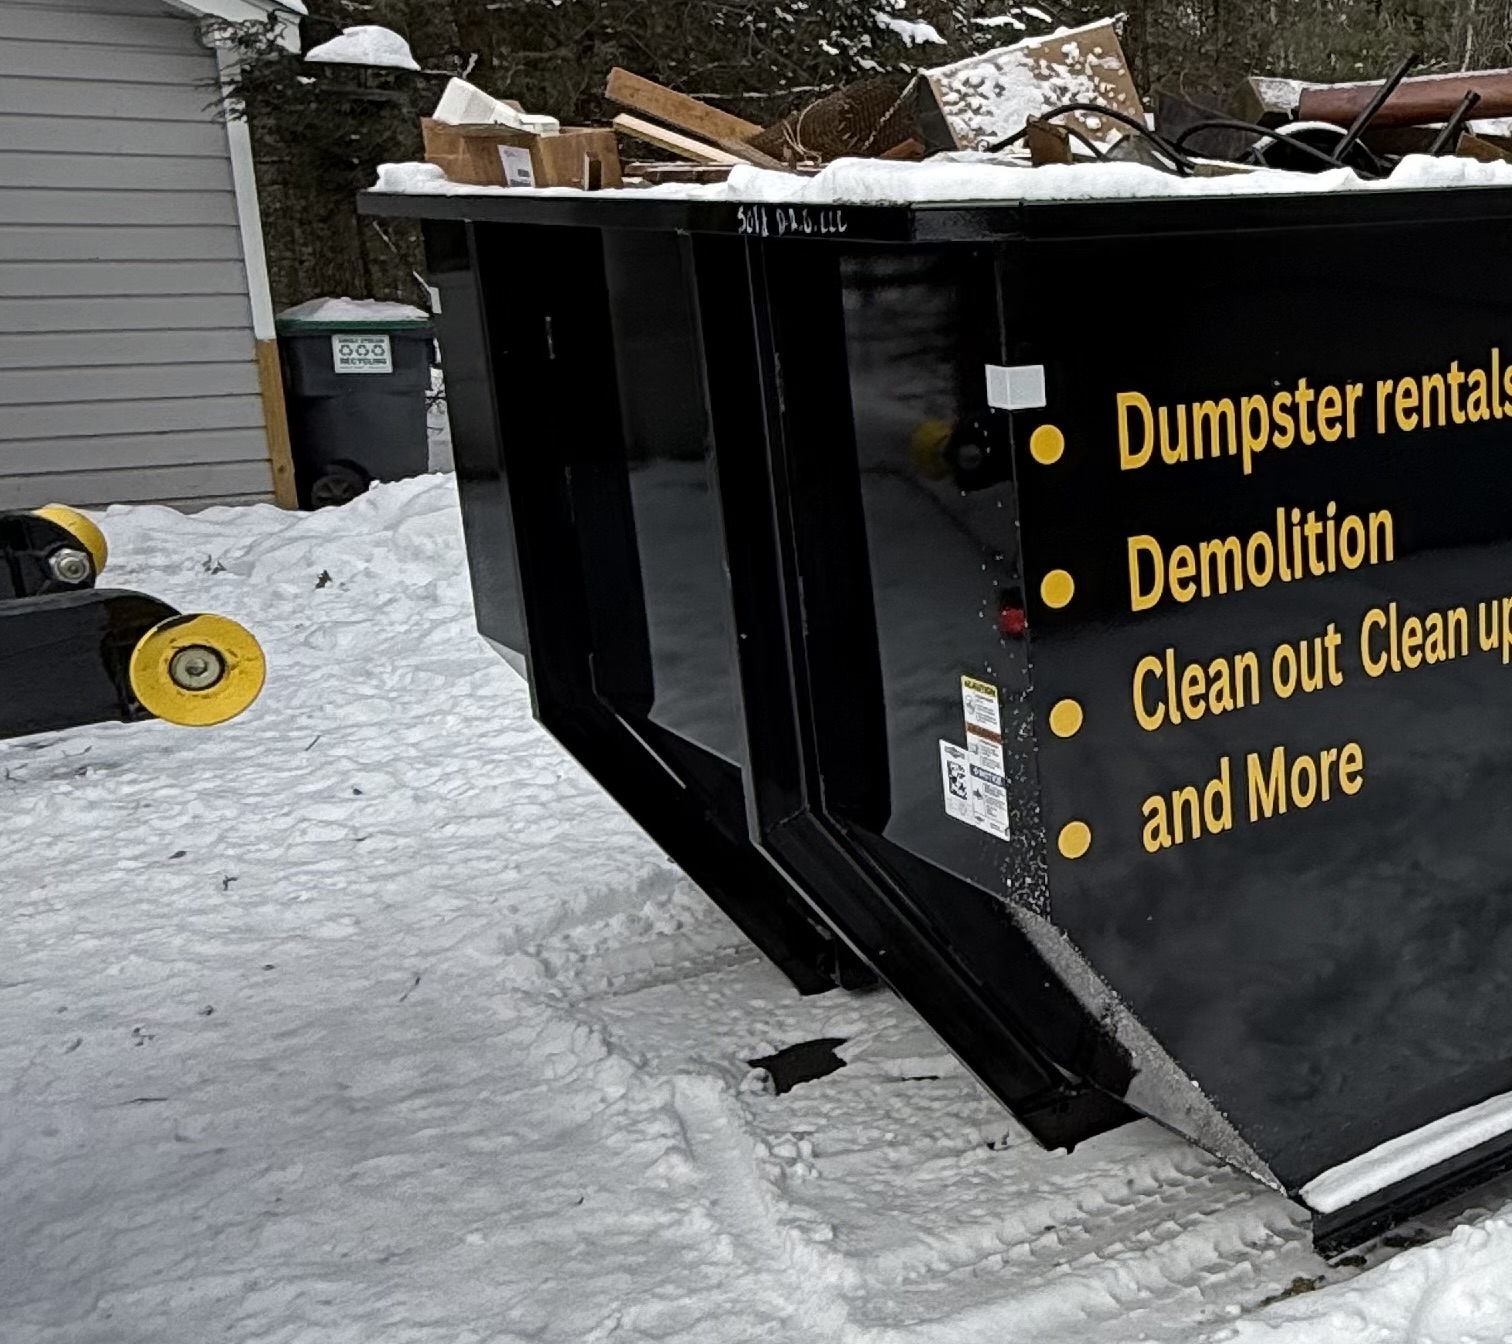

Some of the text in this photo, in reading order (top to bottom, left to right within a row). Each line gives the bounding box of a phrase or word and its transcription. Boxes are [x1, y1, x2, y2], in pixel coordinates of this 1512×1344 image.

[1115, 378, 1364, 476] Dumpster
[1127, 501, 1395, 613] Demolition
[1132, 648, 1261, 733] Clean
[1272, 623, 1345, 700] out
[1359, 602, 1469, 678] Clean
[1141, 741, 1365, 854] and More
